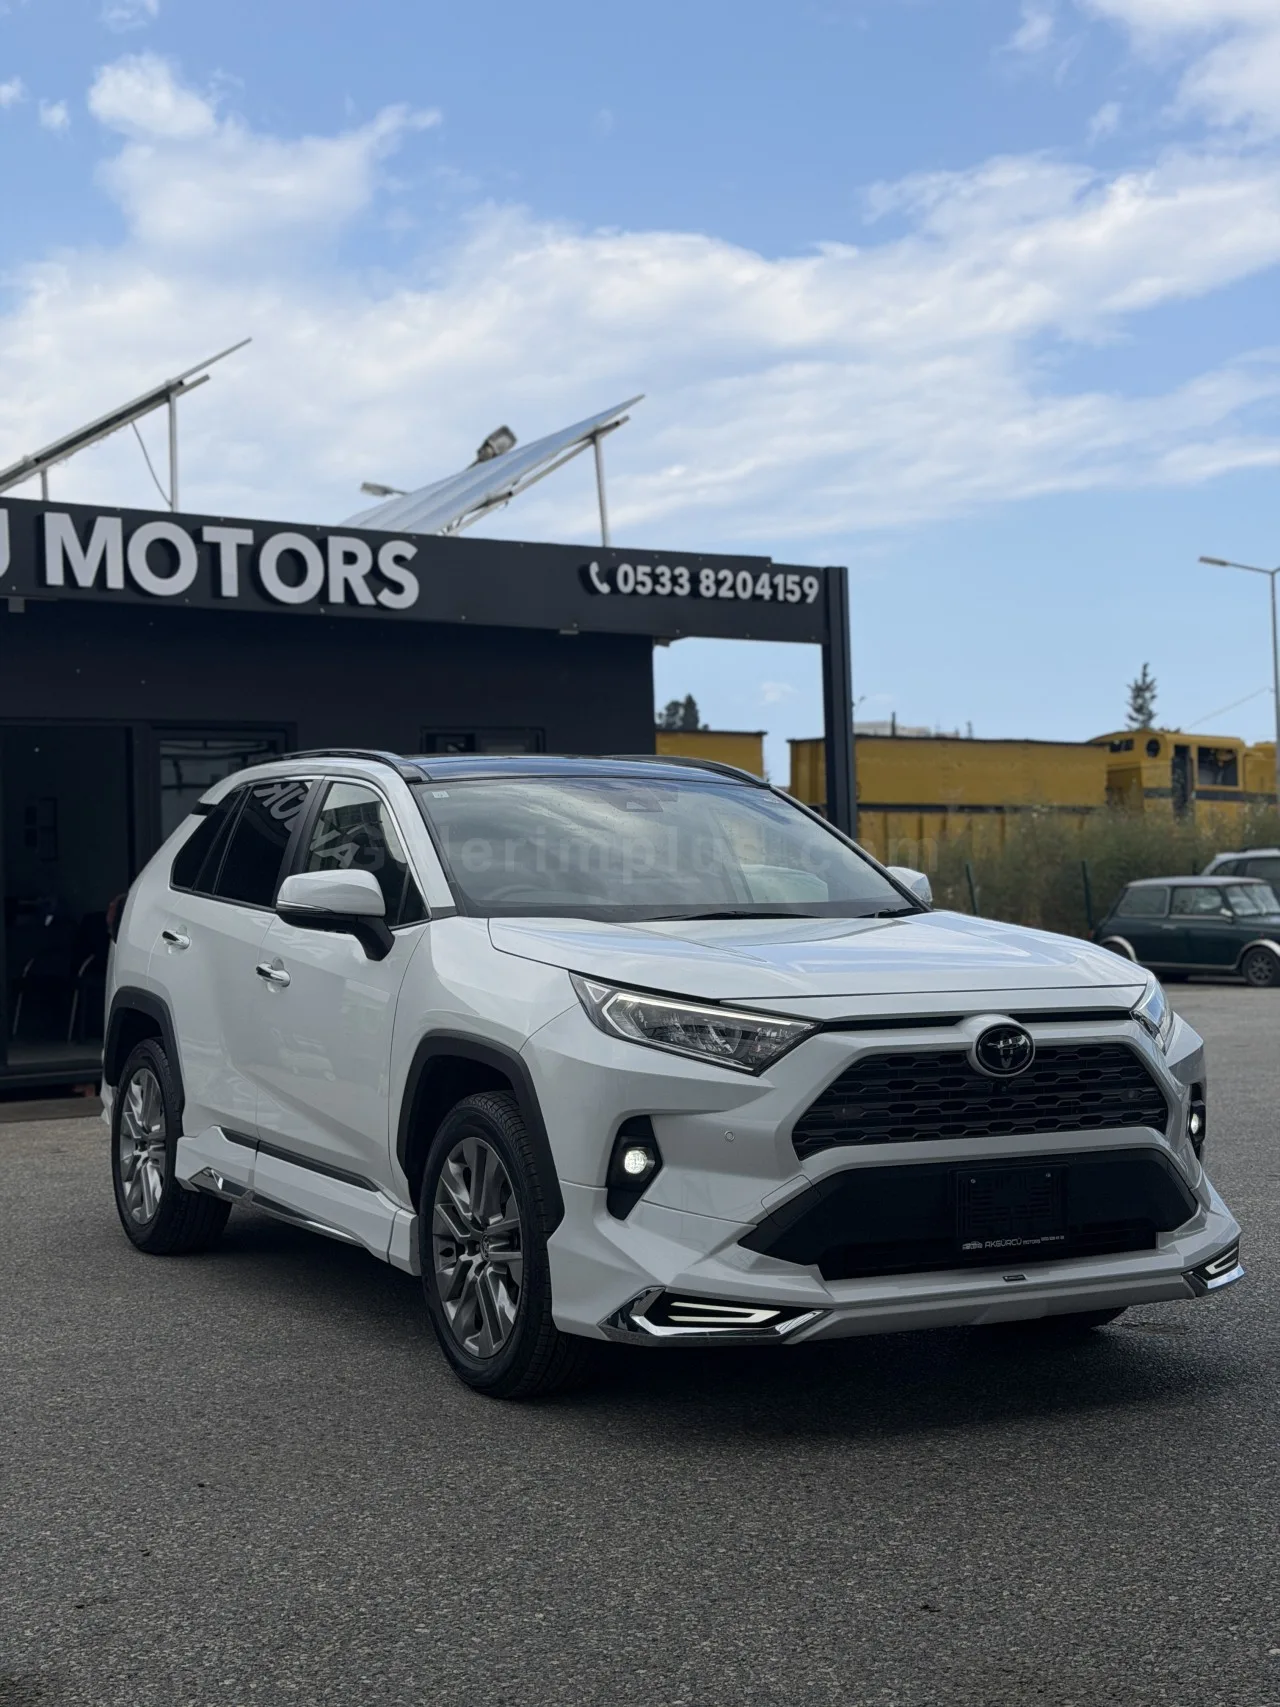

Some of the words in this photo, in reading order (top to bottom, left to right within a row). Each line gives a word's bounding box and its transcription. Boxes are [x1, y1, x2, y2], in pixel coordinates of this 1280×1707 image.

[43, 511, 420, 609] MOTORS
[616, 563, 691, 596] 0533
[699, 568, 819, 604] 8204159
